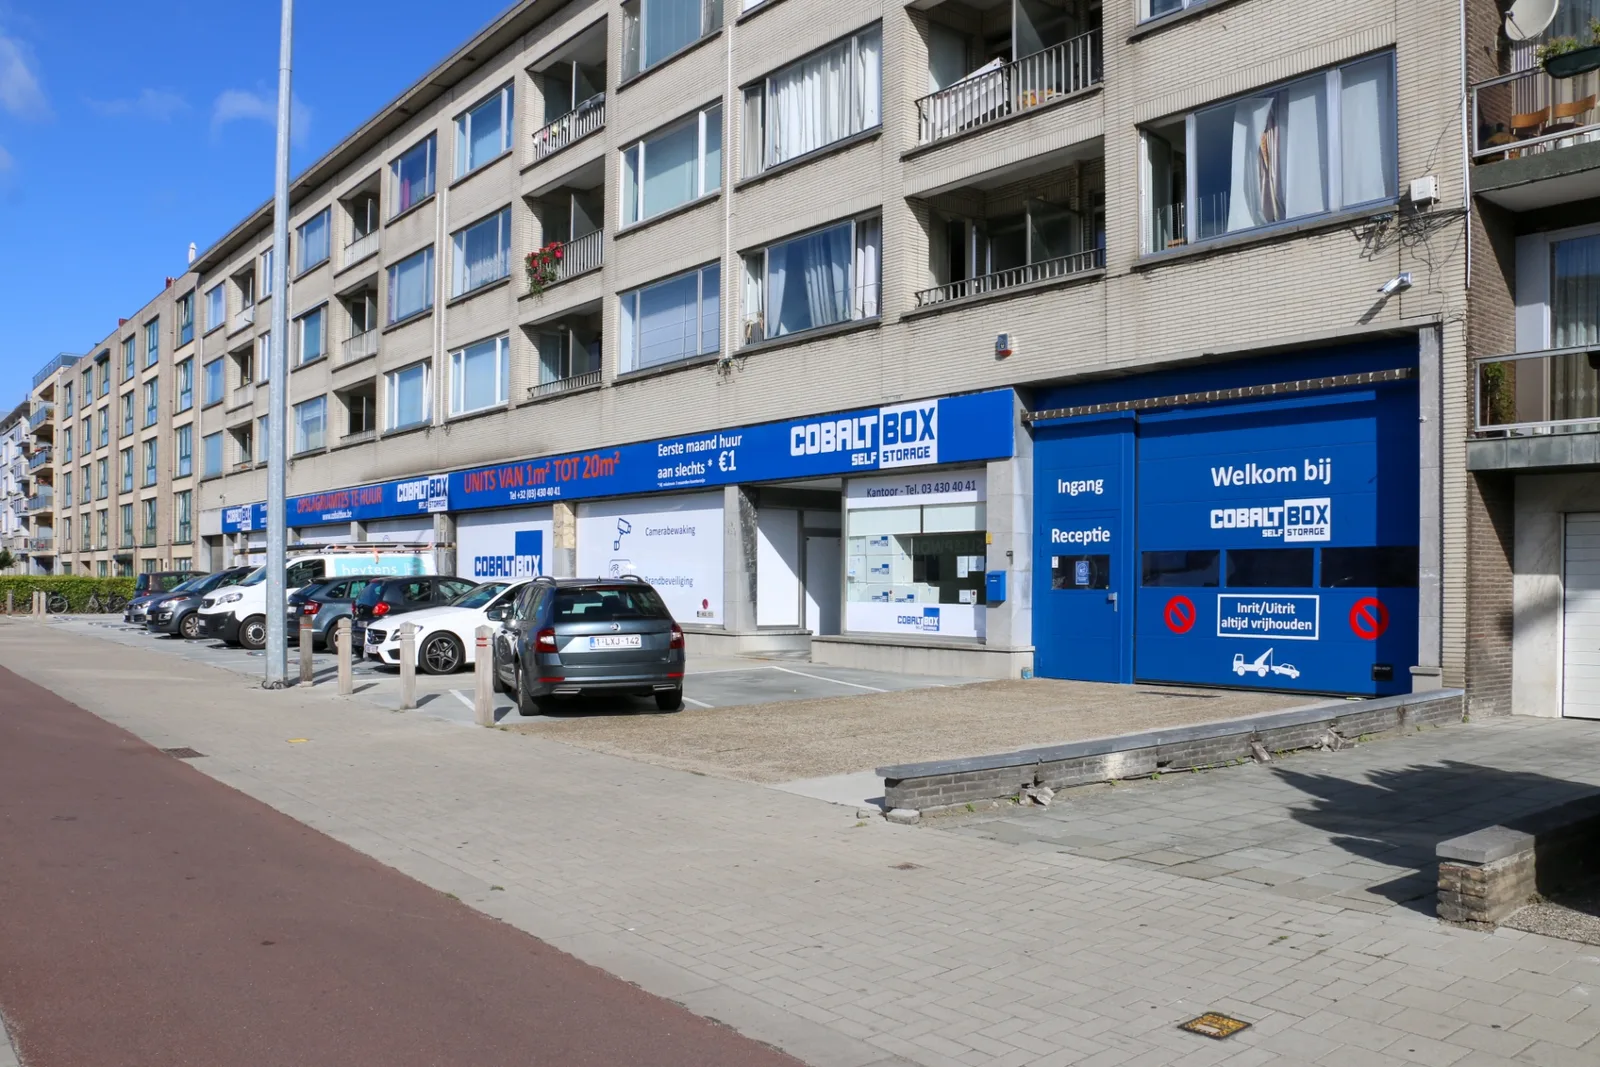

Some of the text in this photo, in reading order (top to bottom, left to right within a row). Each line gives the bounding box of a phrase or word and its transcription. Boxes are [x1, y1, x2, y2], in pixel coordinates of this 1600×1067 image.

[790, 406, 935, 457] COBALT BOX
[657, 434, 743, 457] Eerste maand huur
[657, 450, 737, 479] aan slechts €1
[851, 446, 931, 466] SELF STORAGE
[463, 469, 496, 494] UNITS
[498, 464, 524, 488] VAN
[554, 456, 580, 481] TOT
[1210, 457, 1332, 487] Welkom bij
[397, 477, 448, 503] COBALT BOX
[509, 486, 561, 500] Tel +32 (03) 430 40 41
[866, 486, 898, 498] Kantoor
[905, 484, 920, 496] Tel.
[921, 483, 932, 494] 03
[933, 482, 951, 493] 430
[952, 480, 964, 492] 40
[965, 480, 976, 491] 41
[1057, 478, 1104, 496] Ingang
[297, 486, 383, 514] OPSLAGRUIMTES TE HUUR
[1210, 504, 1329, 529] COBALT BOX
[645, 525, 696, 537] Camerabewaking
[1051, 526, 1111, 546] Receptie
[1262, 527, 1325, 538] SELF STORAGE
[342, 563, 397, 575] heytens
[474, 554, 541, 578] COBALT BOX
[645, 575, 694, 588] Brandbeveiliging
[1237, 601, 1296, 616] Inrit/Uitrit
[897, 615, 939, 626] COBALT BOX
[1221, 617, 1313, 633] altijd vrijhouden
[596, 636, 640, 646] 1-LXJ-142
